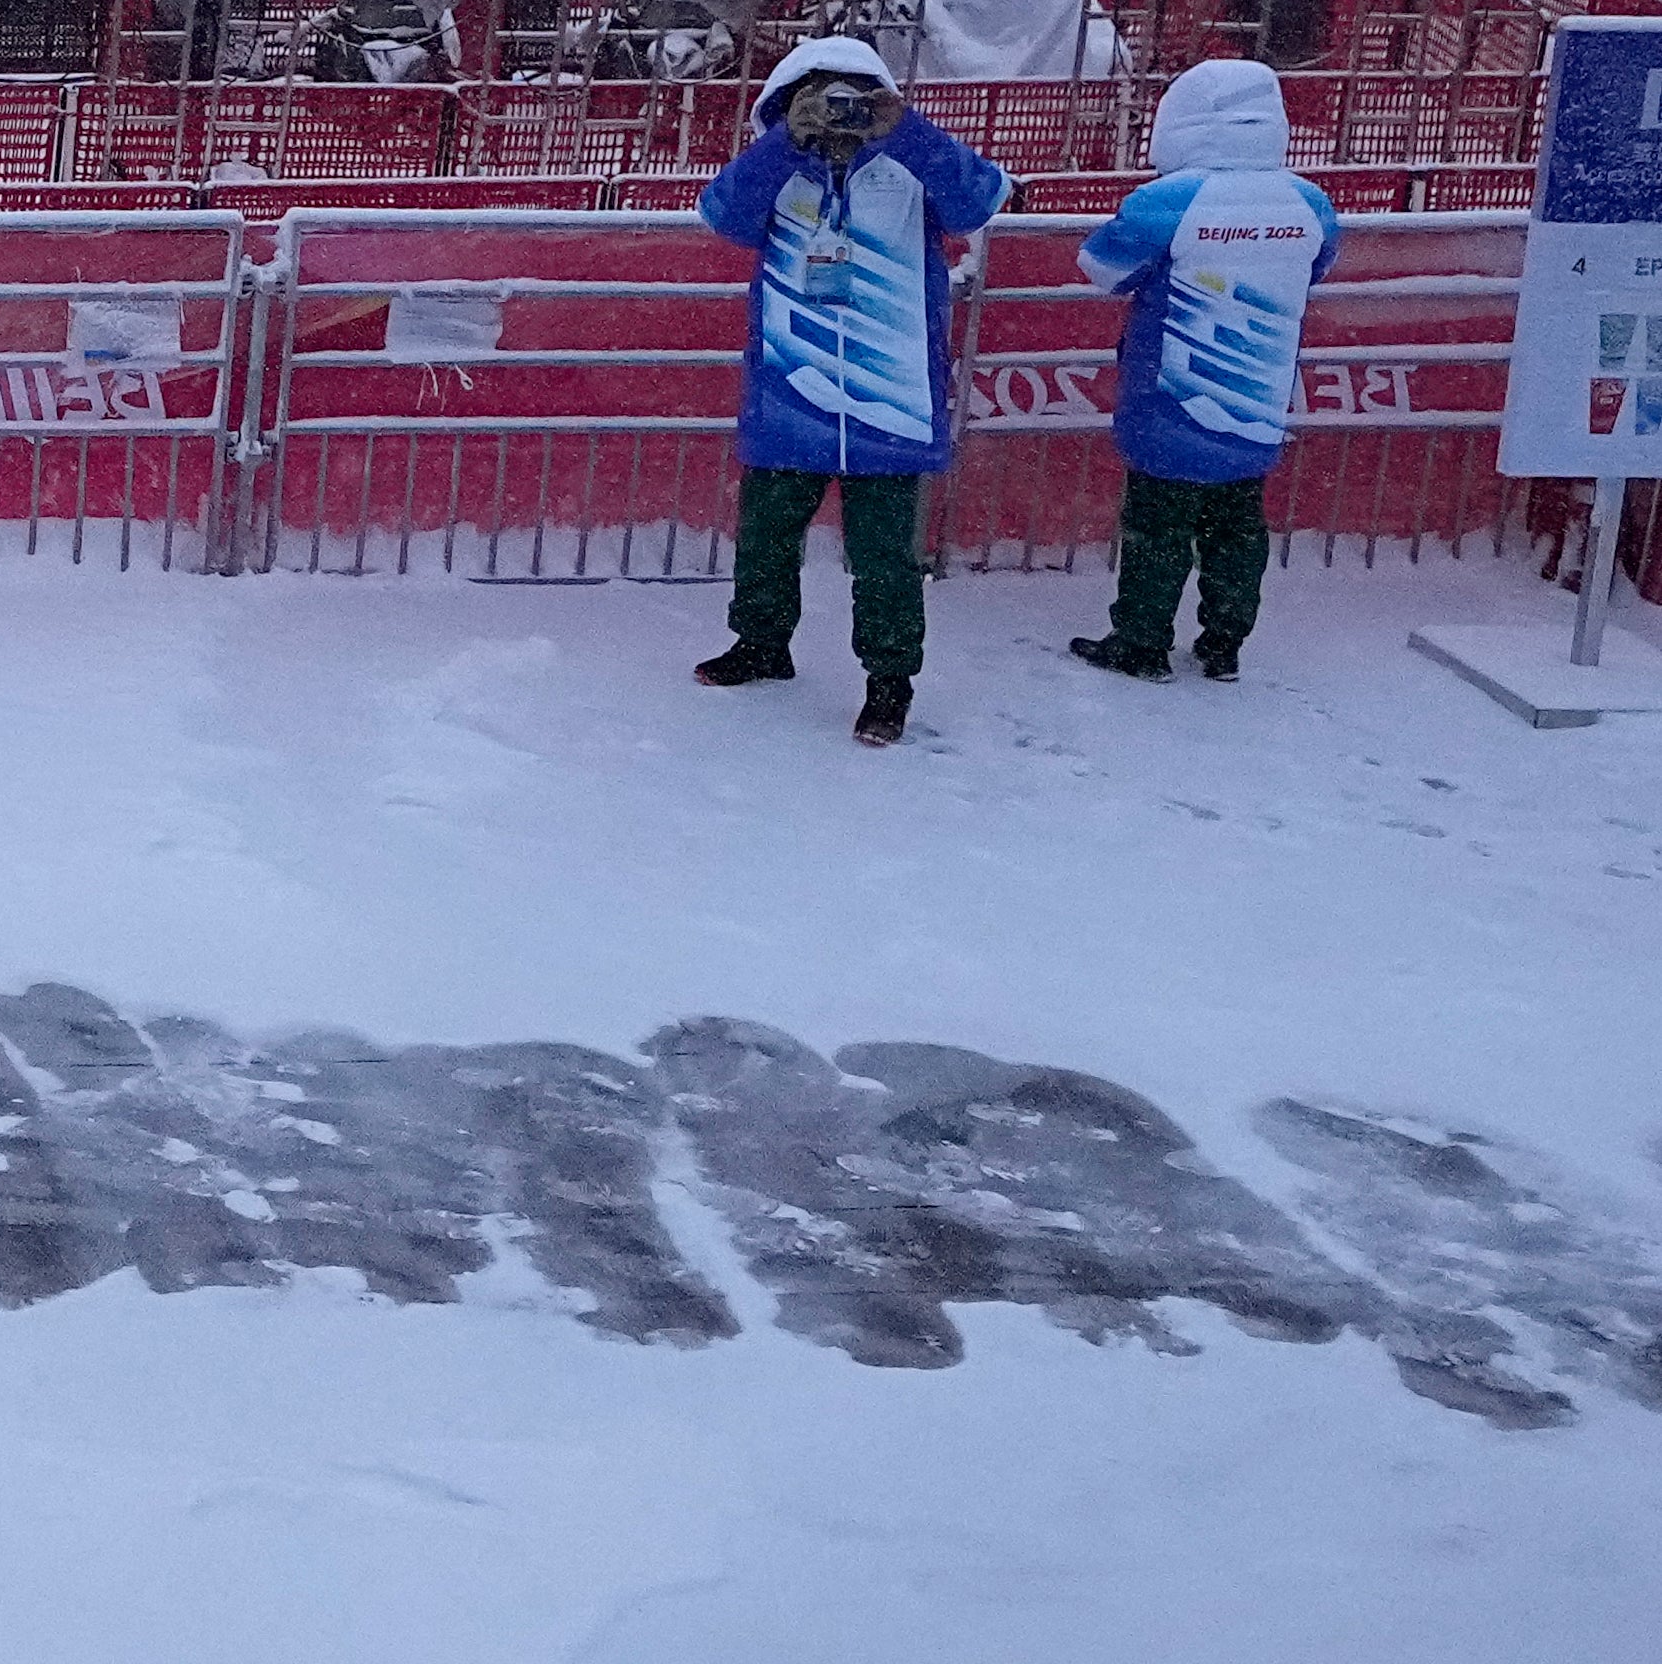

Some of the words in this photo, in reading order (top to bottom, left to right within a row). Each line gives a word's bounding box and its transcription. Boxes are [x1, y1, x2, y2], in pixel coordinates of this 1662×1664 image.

[1197, 226, 1259, 244] BEIJING
[1264, 225, 1307, 240] 2022
[1571, 256, 1586, 276] 4
